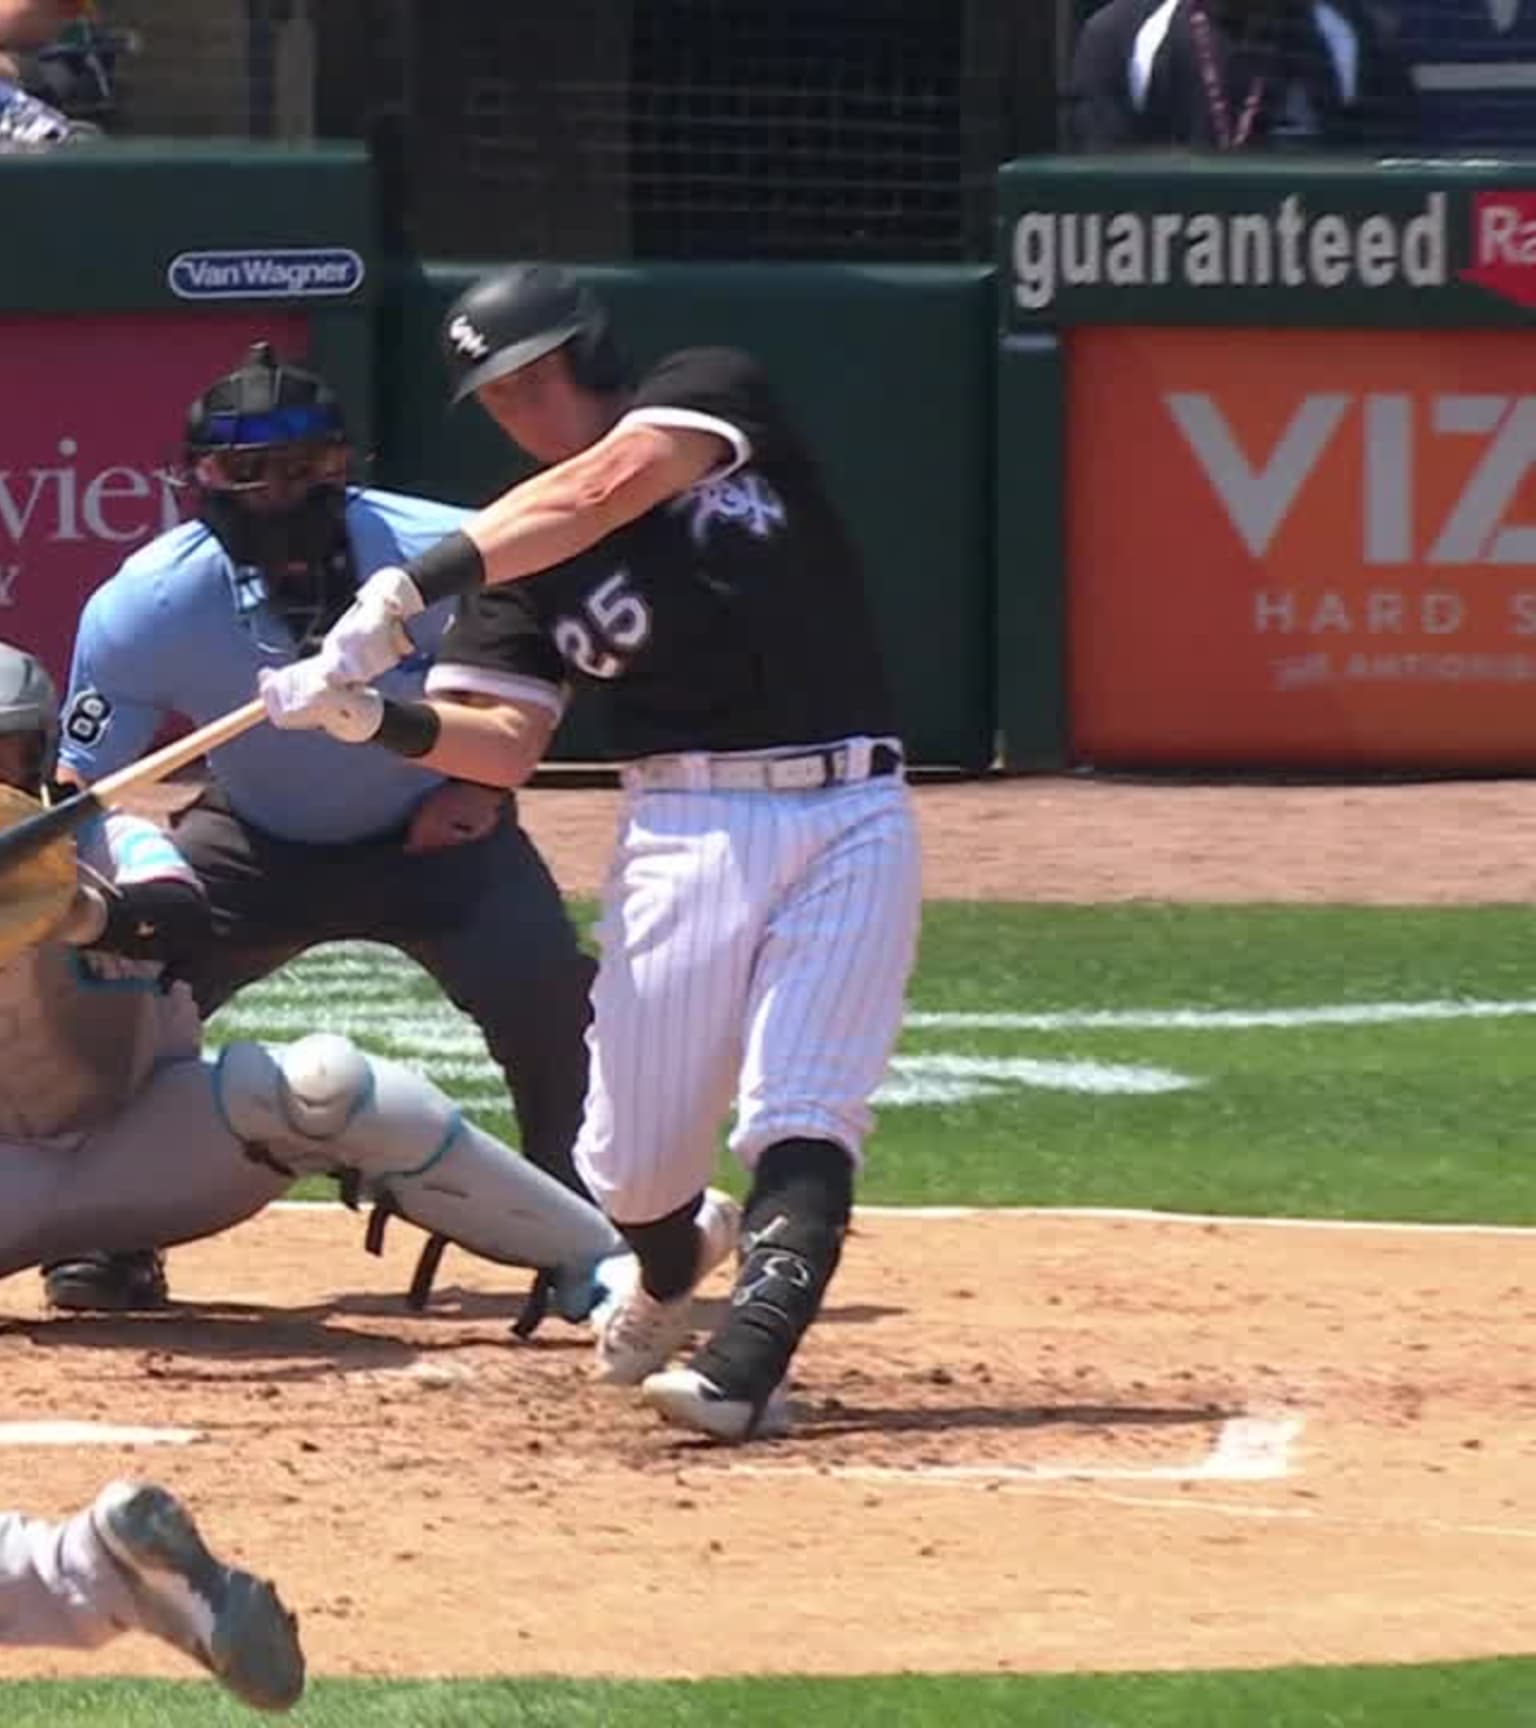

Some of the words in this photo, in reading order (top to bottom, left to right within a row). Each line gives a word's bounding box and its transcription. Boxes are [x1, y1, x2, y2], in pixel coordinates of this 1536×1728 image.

[1013, 192, 1447, 308] guaranteed
[1163, 391, 1536, 565] VIZ
[555, 568, 652, 680] 25
[1252, 591, 1464, 635] HARD
[64, 690, 113, 746] 8
